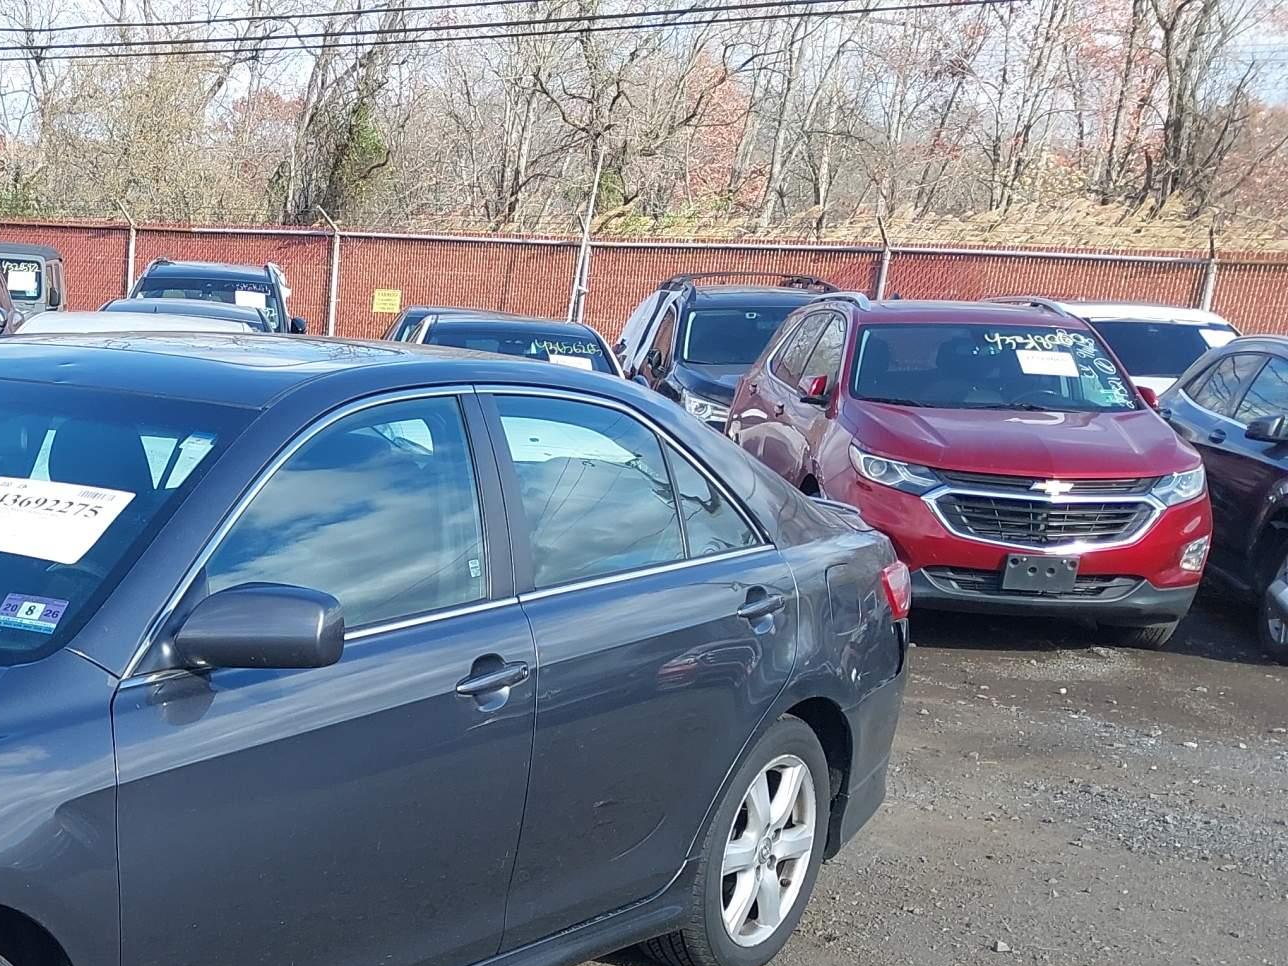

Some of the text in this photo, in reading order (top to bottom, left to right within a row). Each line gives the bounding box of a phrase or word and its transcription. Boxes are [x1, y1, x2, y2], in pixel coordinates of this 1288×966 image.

[2, 603, 61, 619] 20 8 26
